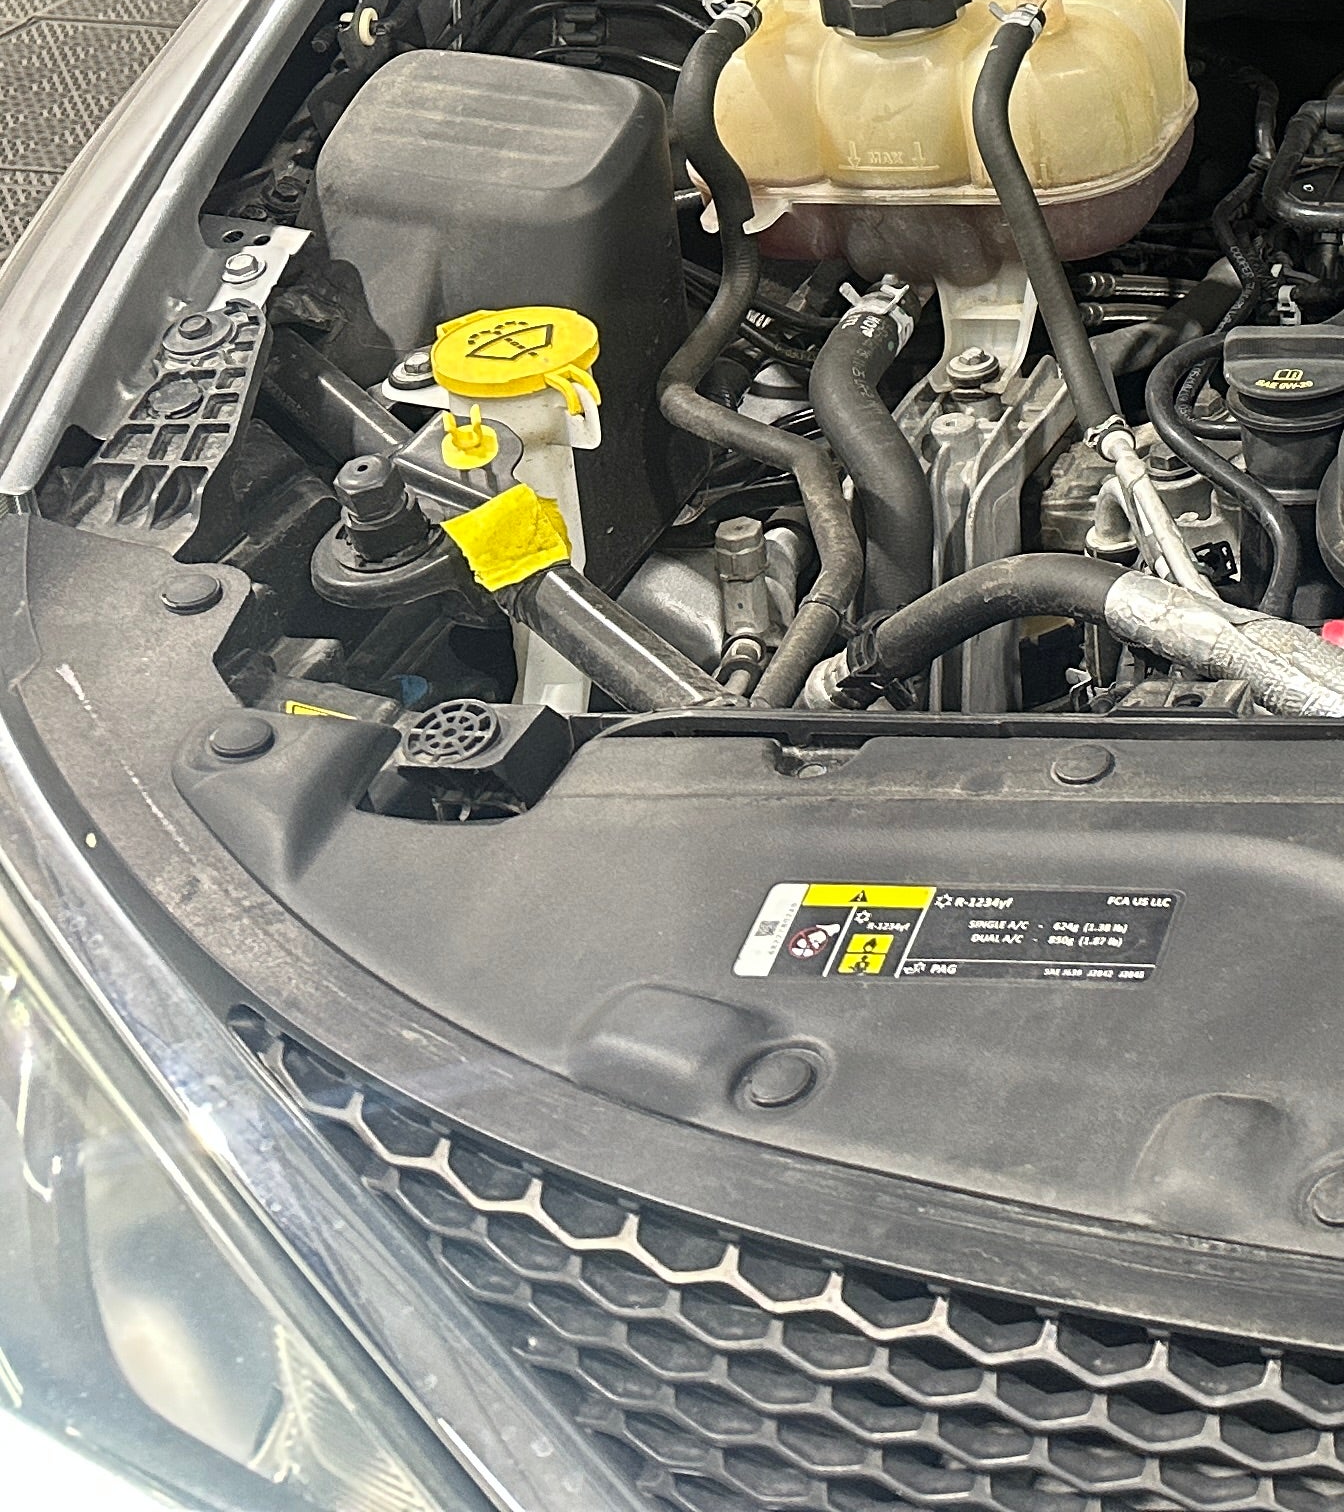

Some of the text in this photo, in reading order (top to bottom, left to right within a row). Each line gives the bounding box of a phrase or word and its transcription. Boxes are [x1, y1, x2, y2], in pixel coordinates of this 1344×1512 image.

[1106, 896, 1131, 907] FCA
[1150, 897, 1172, 908] LLC
[1007, 920, 1030, 931] A/C
[1002, 934, 1024, 944] A/C
[929, 963, 958, 975] PAG
